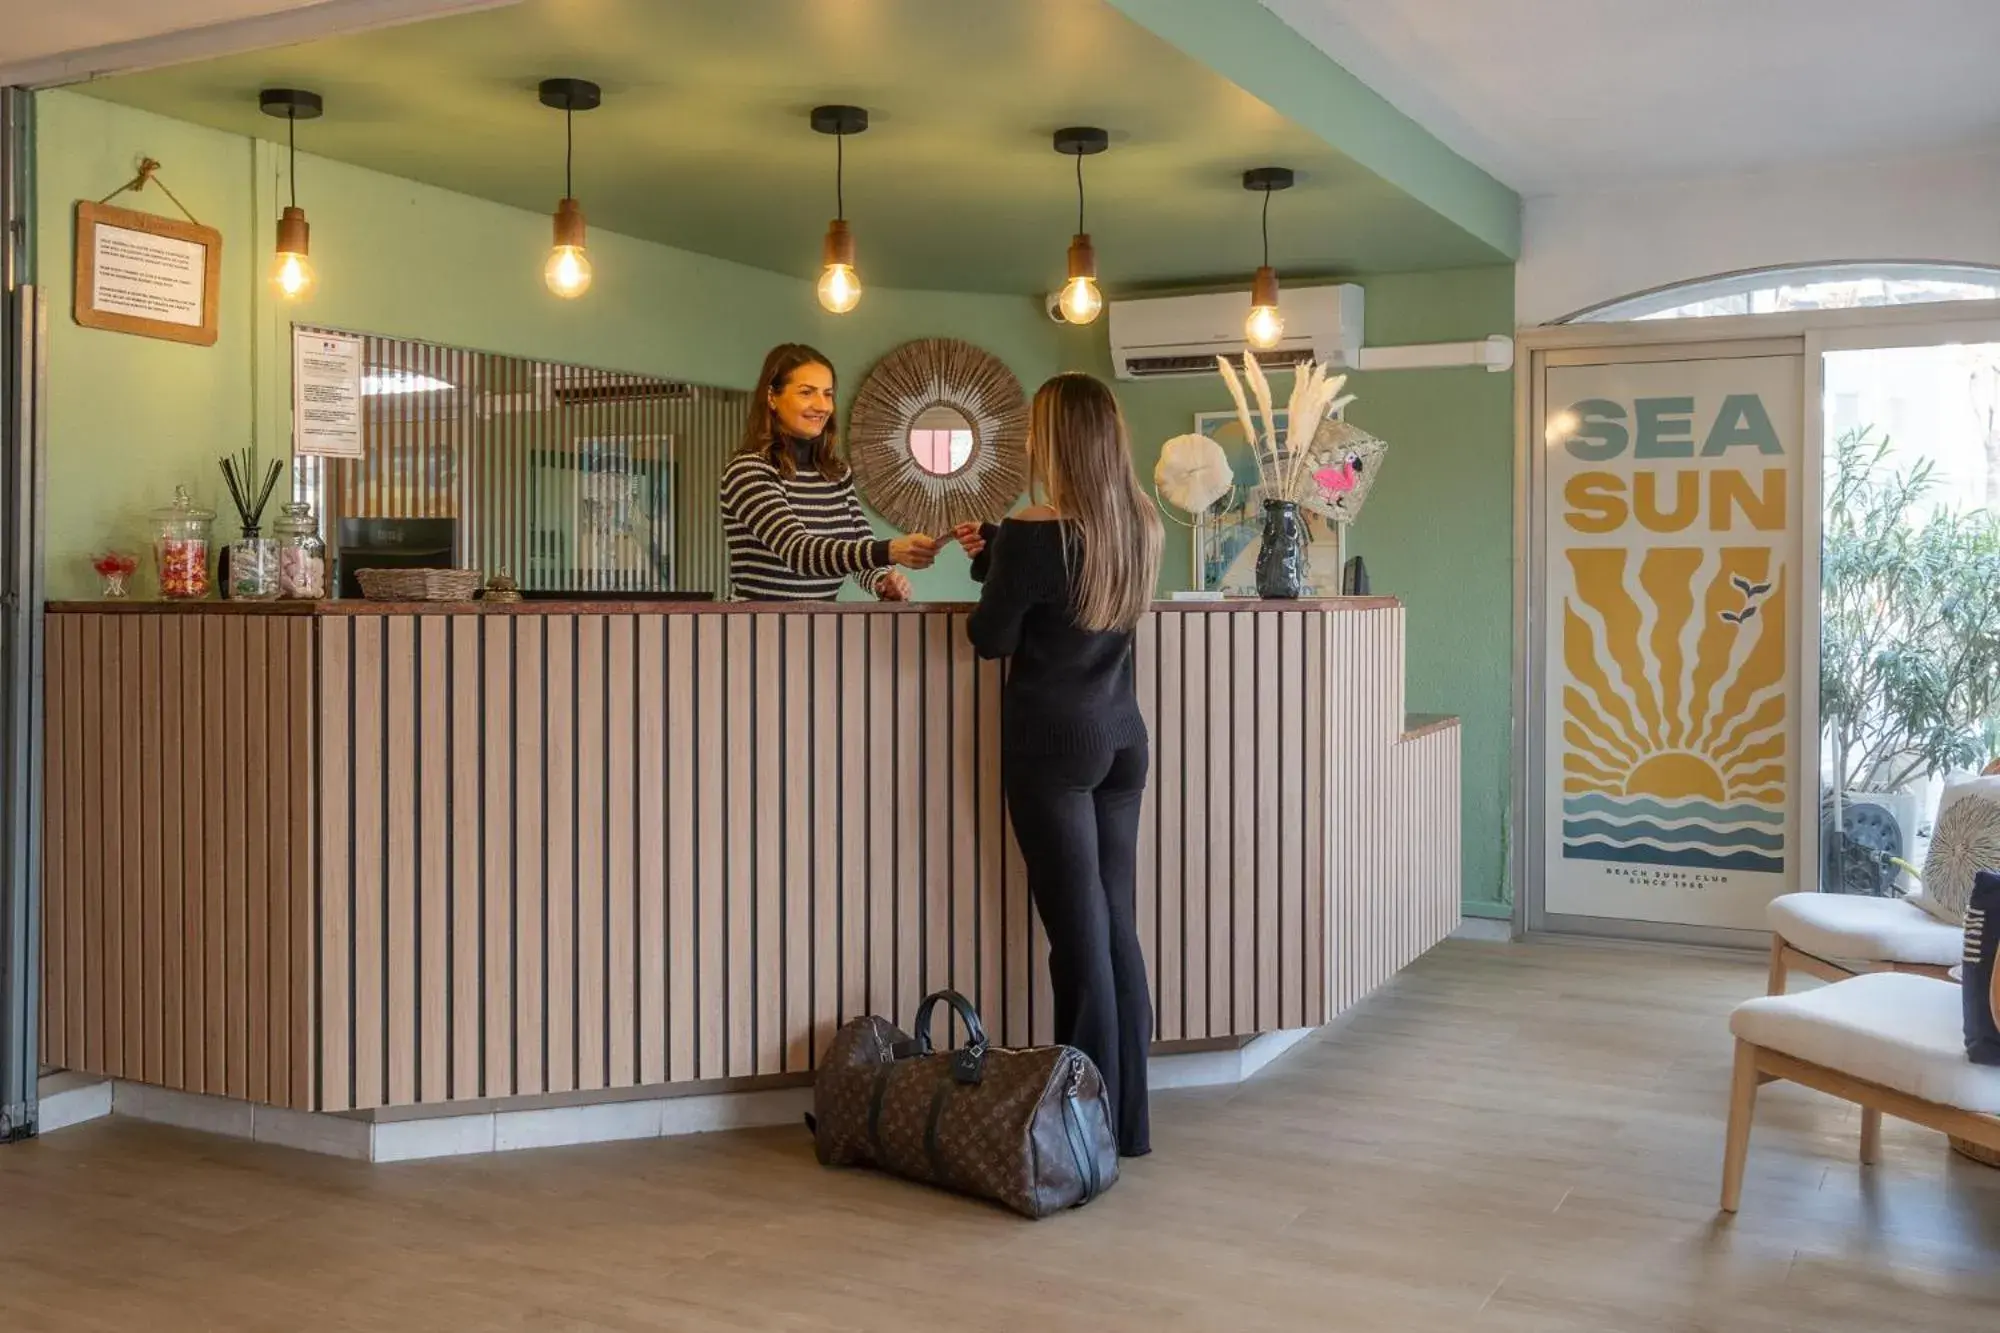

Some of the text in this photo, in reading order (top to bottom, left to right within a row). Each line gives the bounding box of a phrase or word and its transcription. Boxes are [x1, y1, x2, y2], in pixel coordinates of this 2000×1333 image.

[1565, 394, 1785, 461] SEA
[1564, 469, 1787, 533] SUN
[1606, 867, 1648, 876] BEACH
